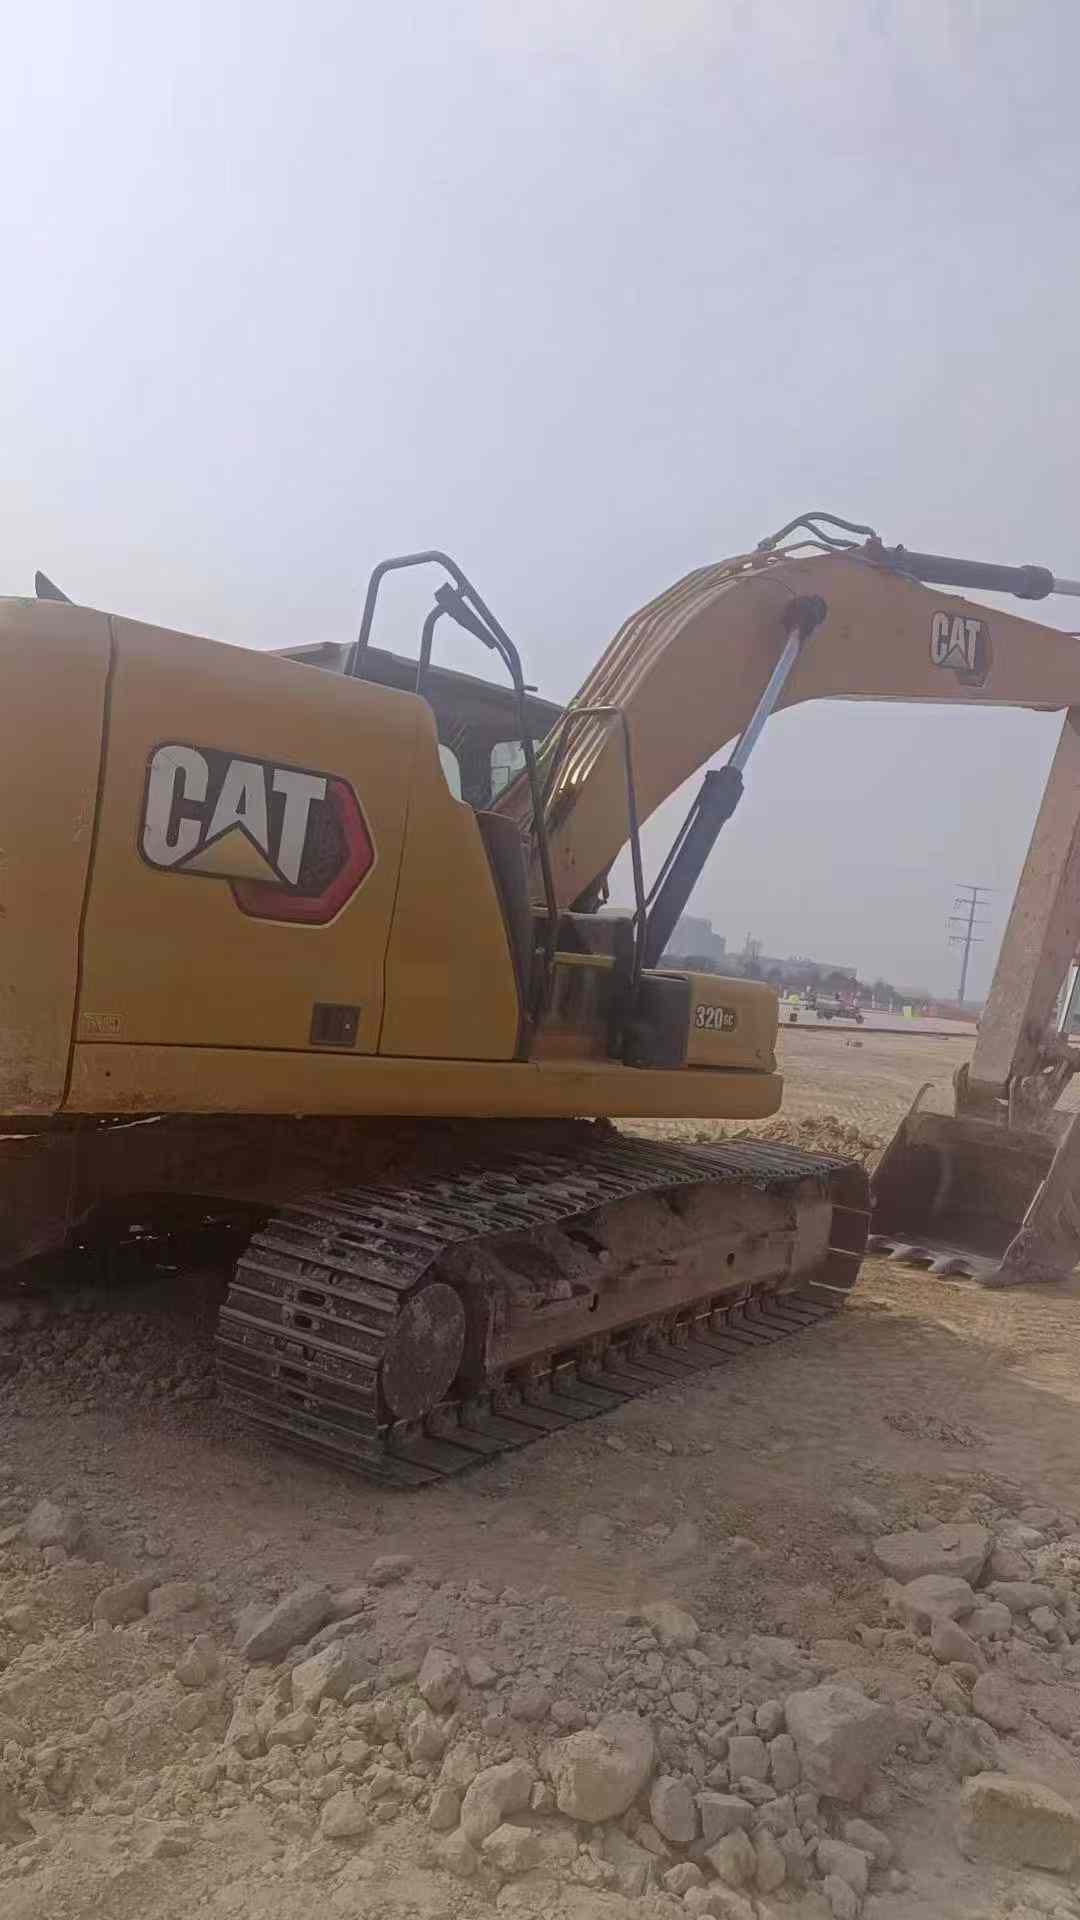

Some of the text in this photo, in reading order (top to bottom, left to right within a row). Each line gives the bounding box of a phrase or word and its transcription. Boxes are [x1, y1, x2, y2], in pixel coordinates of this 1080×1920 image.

[931, 612, 981, 670] CAT
[143, 745, 327, 885] CAT
[695, 1006, 723, 1029] 320
